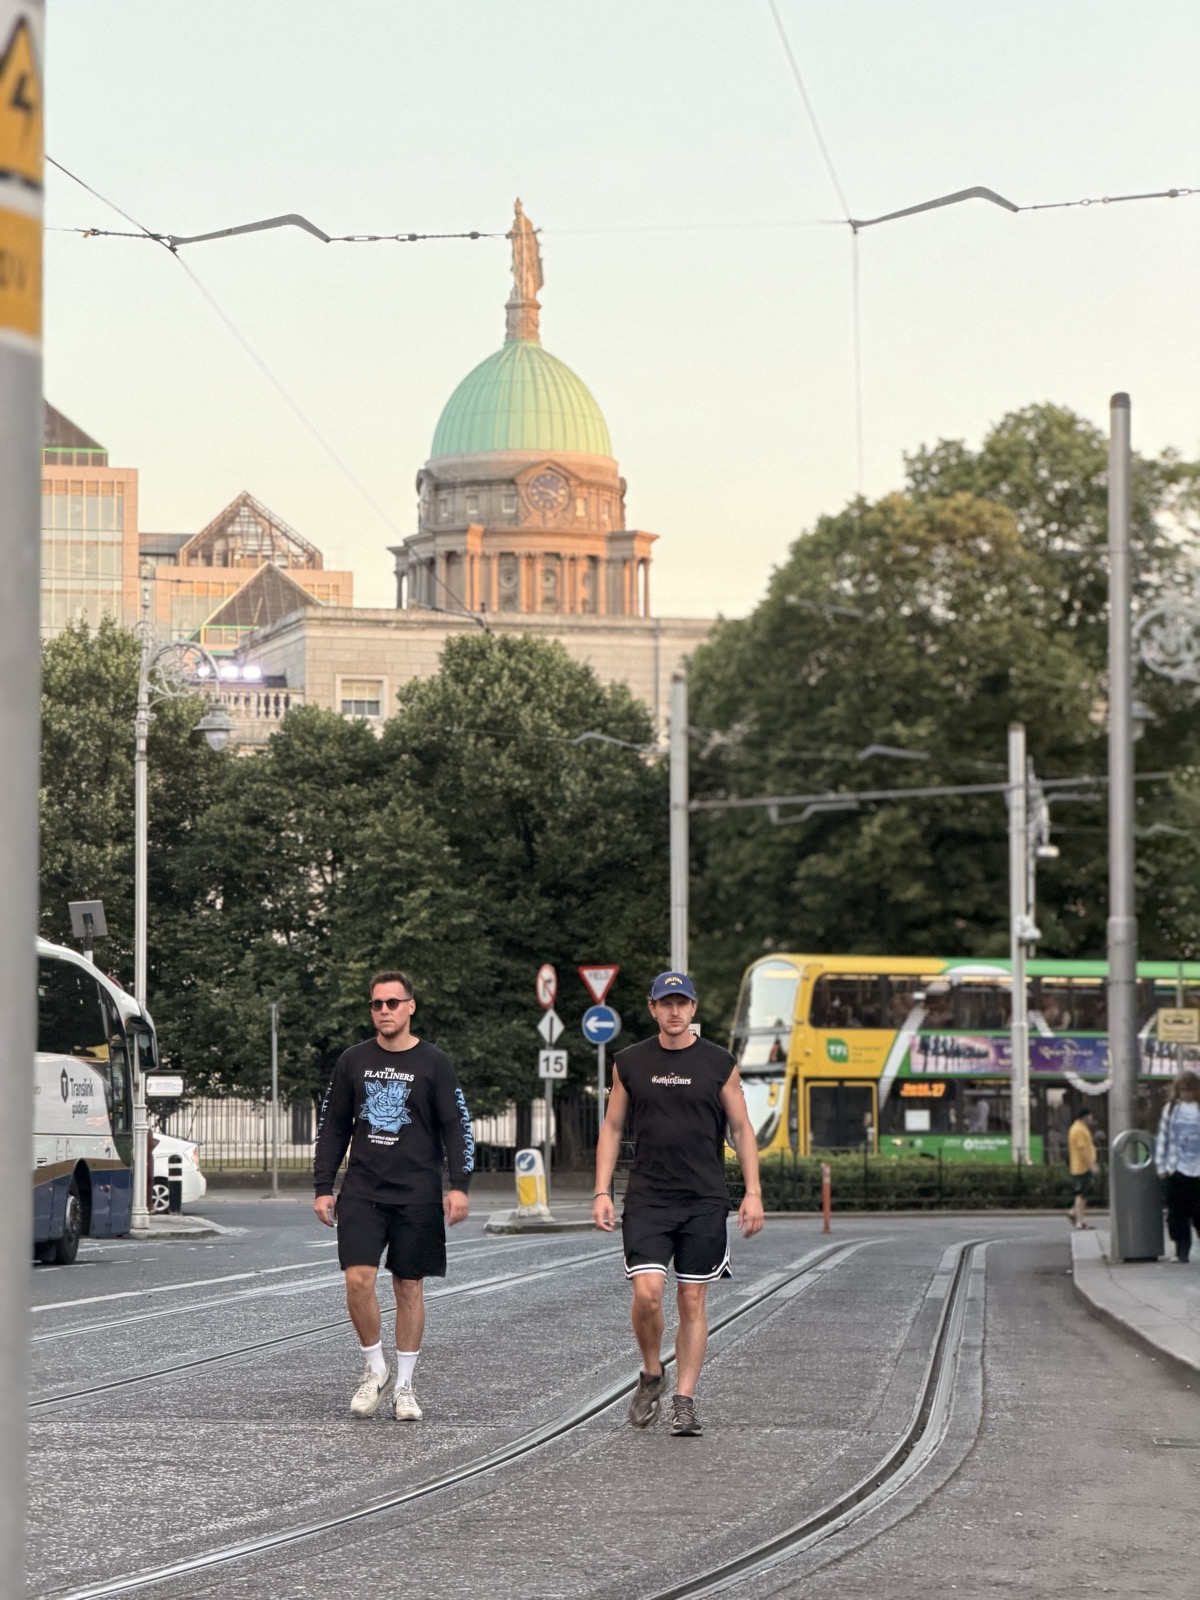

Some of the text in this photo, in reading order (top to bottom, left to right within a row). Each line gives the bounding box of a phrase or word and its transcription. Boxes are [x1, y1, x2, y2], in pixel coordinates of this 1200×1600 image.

[543, 1055, 563, 1073] 15
[364, 1070, 415, 1081] FLATLINERS
[69, 1077, 94, 1097] Translink
